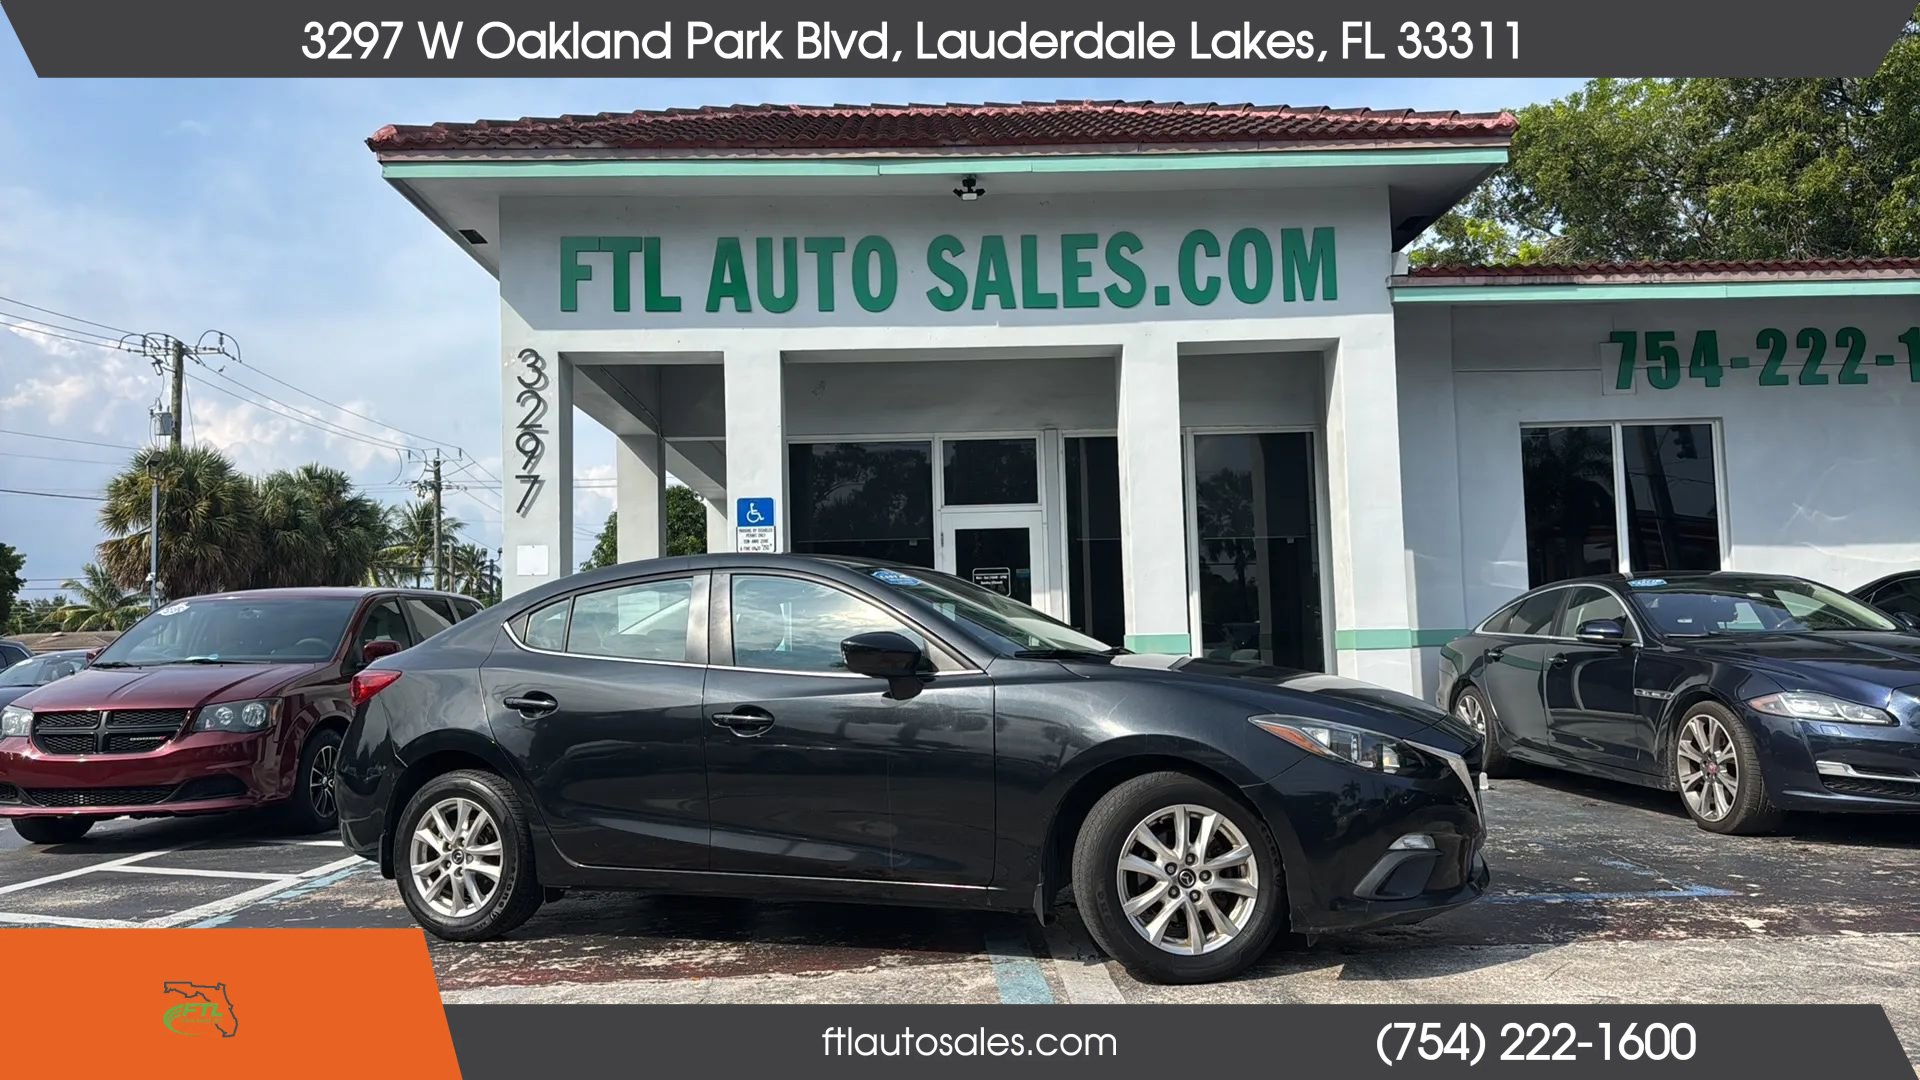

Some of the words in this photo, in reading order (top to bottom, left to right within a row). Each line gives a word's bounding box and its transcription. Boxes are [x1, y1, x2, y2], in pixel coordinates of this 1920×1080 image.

[559, 236, 682, 313] FTL
[705, 235, 898, 314] AUTO
[926, 226, 1338, 311] SALES.COM
[515, 348, 544, 516] 3297
